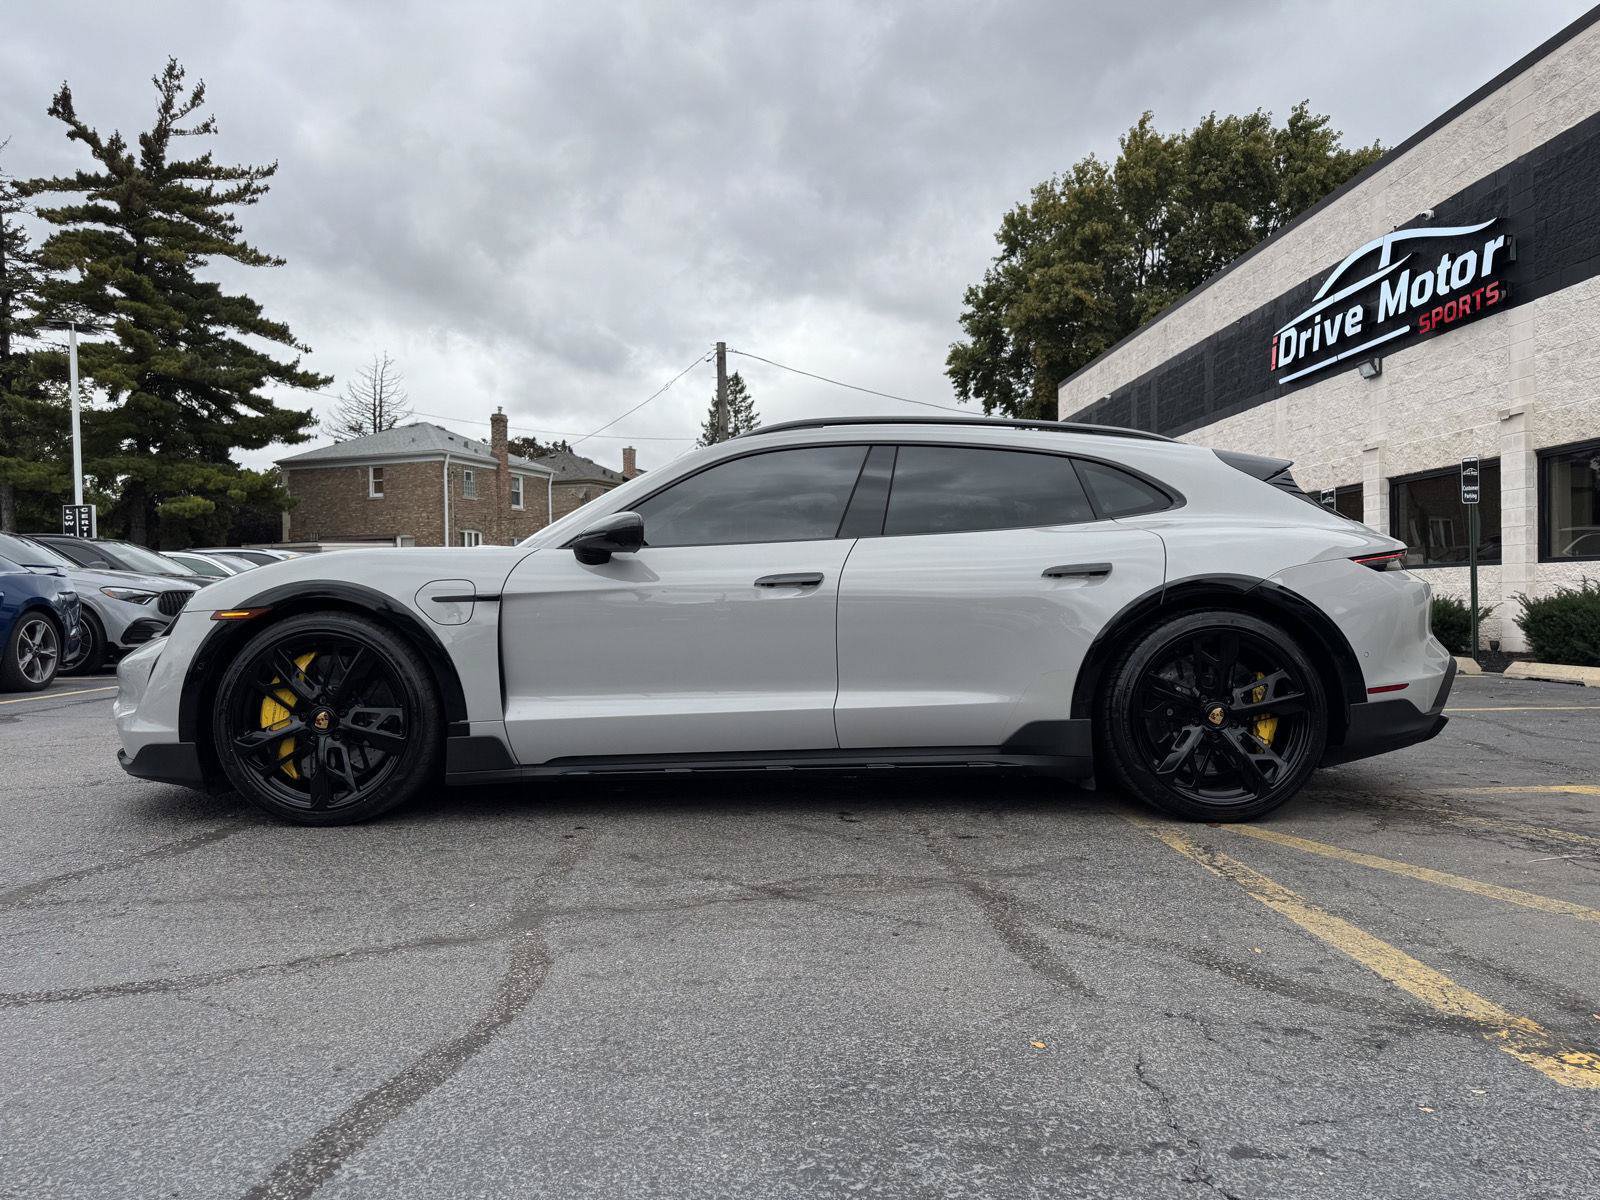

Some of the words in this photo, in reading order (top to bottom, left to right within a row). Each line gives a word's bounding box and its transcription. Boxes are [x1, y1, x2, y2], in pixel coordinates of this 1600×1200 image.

[1270, 304, 1363, 371] iDrive
[1378, 234, 1504, 323] Motor
[1418, 281, 1500, 334] SPORTS
[65, 509, 74, 526] LOW
